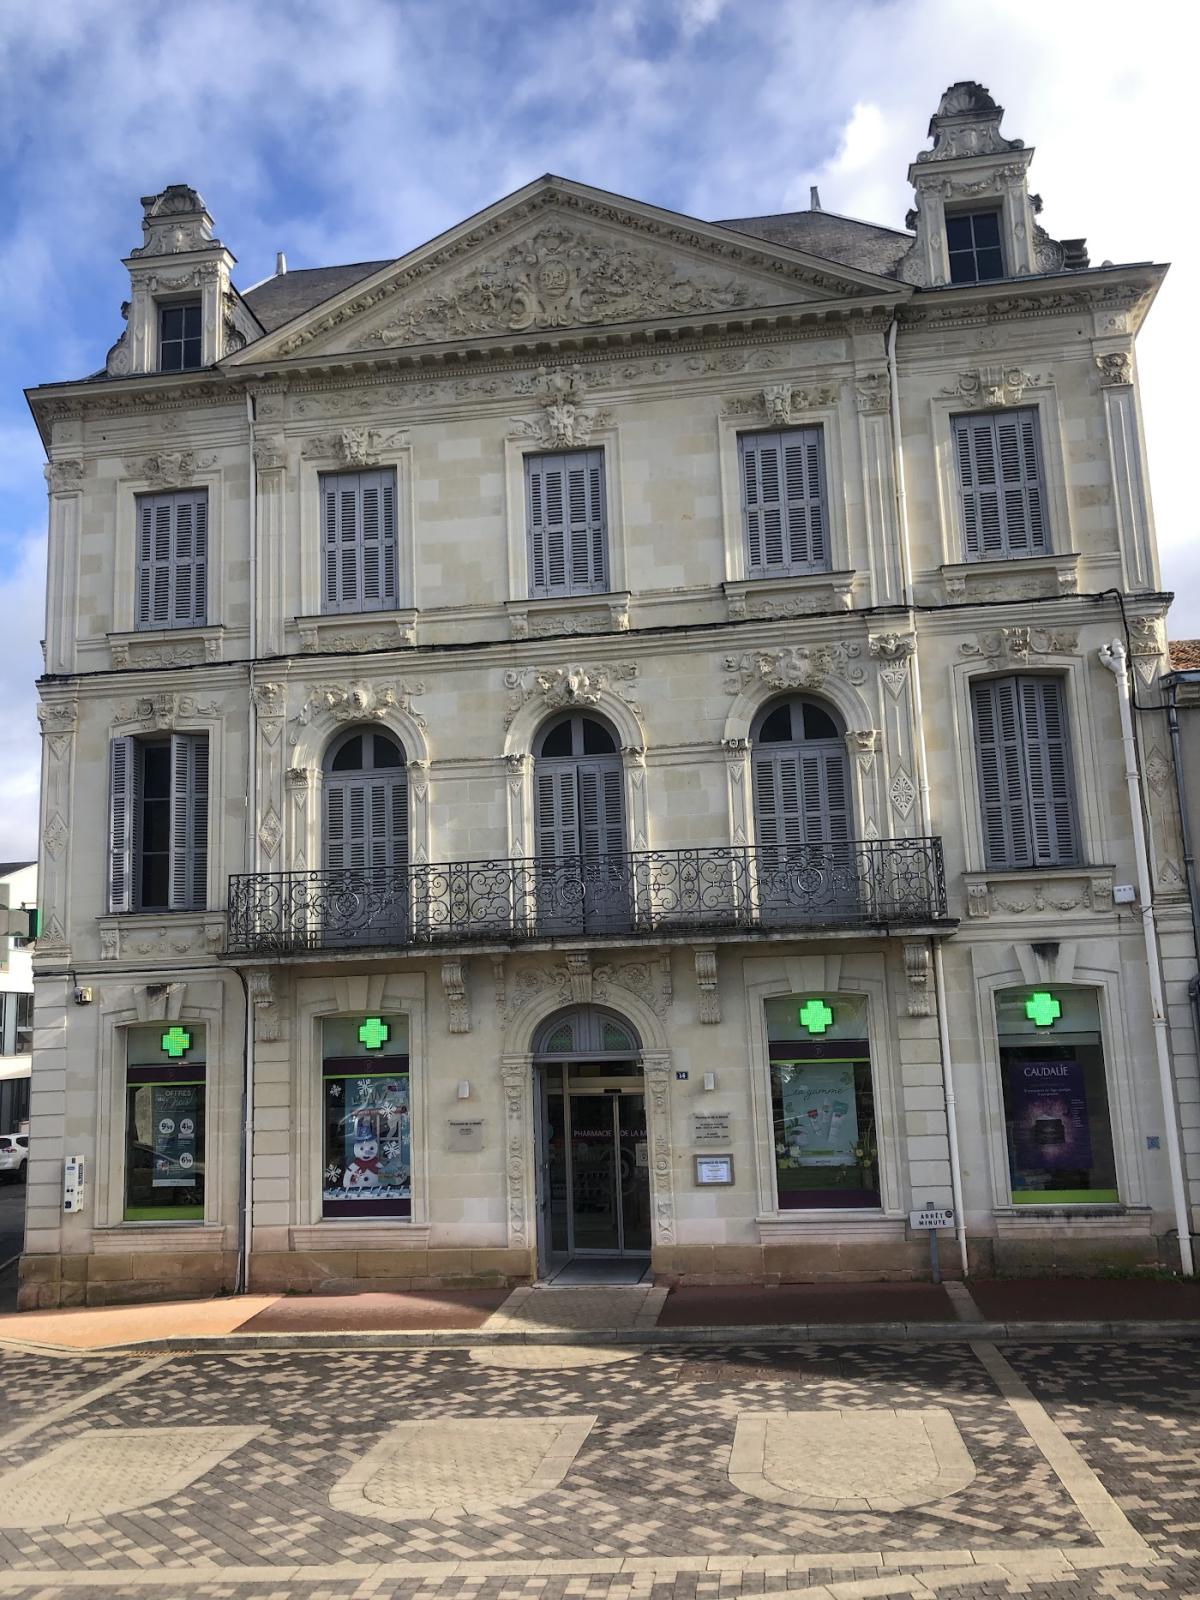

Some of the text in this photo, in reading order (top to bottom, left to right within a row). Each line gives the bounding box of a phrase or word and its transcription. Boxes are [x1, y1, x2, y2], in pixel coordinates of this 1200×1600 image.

[573, 1129, 612, 1137] PHARMACIE
[620, 1129, 629, 1137] DE
[630, 1129, 639, 1137] LA
[920, 1212, 943, 1220] ARRÊT
